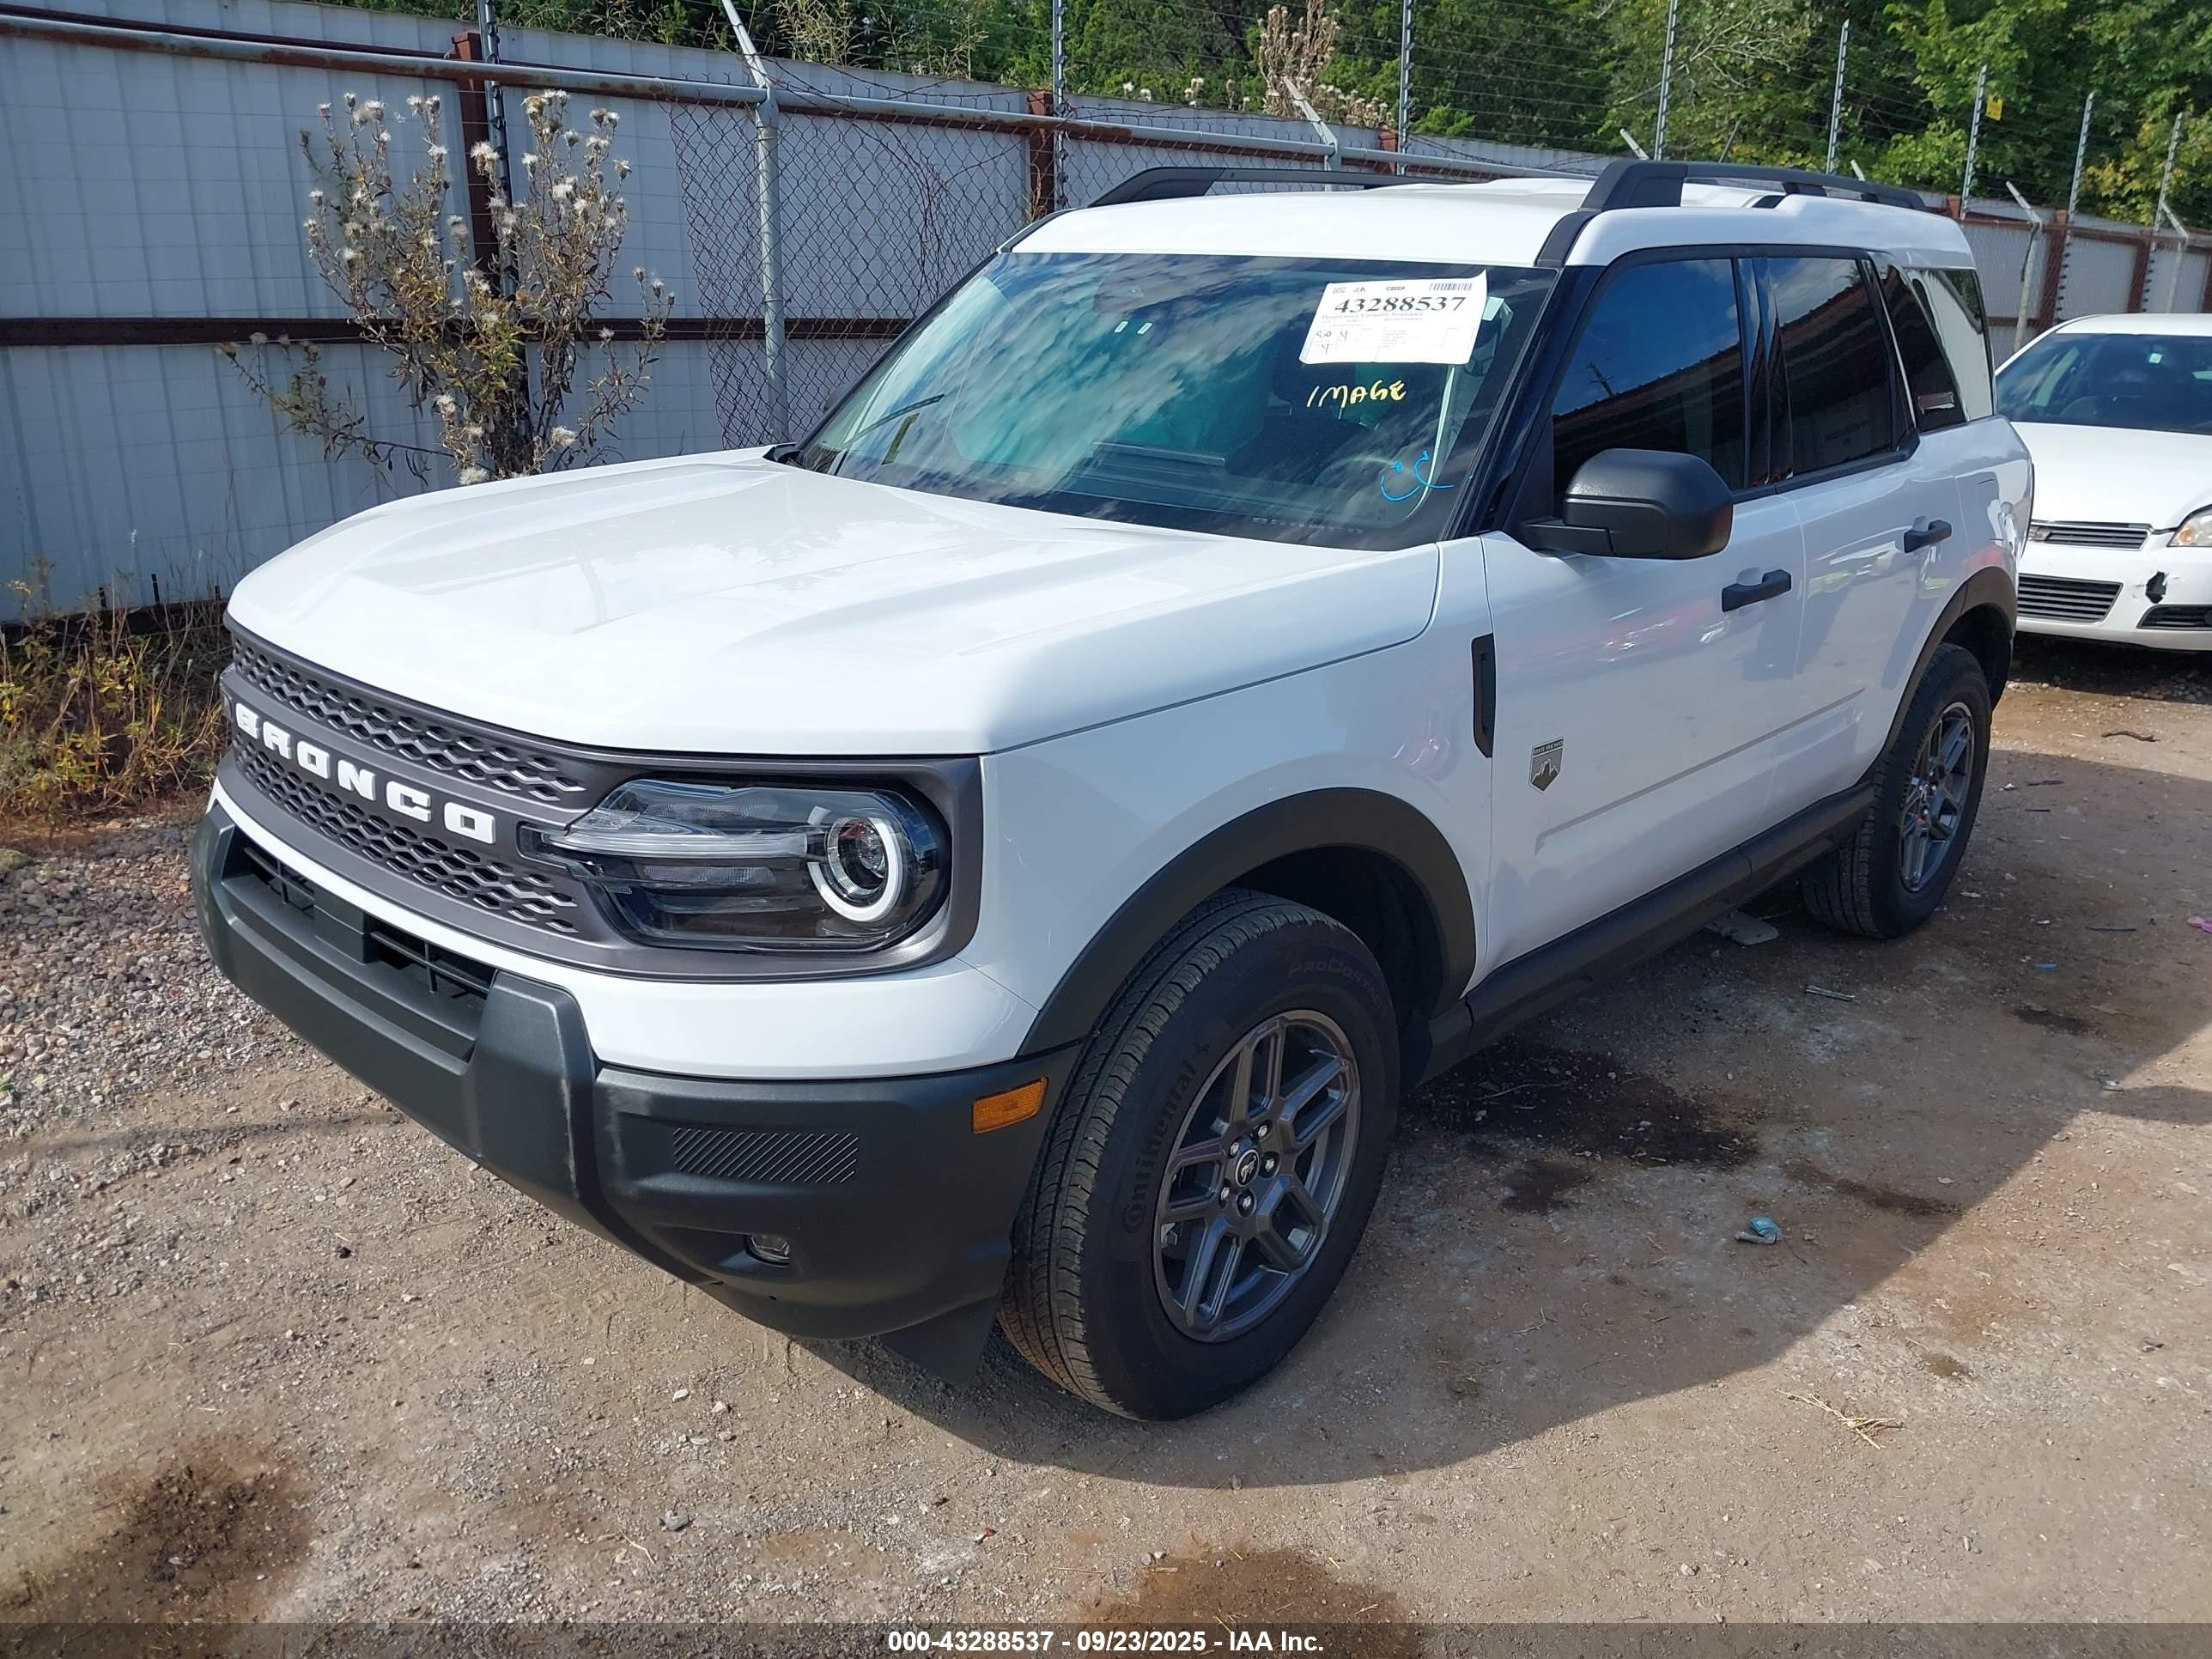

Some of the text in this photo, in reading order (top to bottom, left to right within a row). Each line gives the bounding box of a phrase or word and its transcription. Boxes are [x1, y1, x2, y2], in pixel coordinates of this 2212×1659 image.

[1334, 295, 1468, 314] 43288537
[1306, 380, 1407, 409] IMAGE
[234, 702, 496, 844] BRONCO
